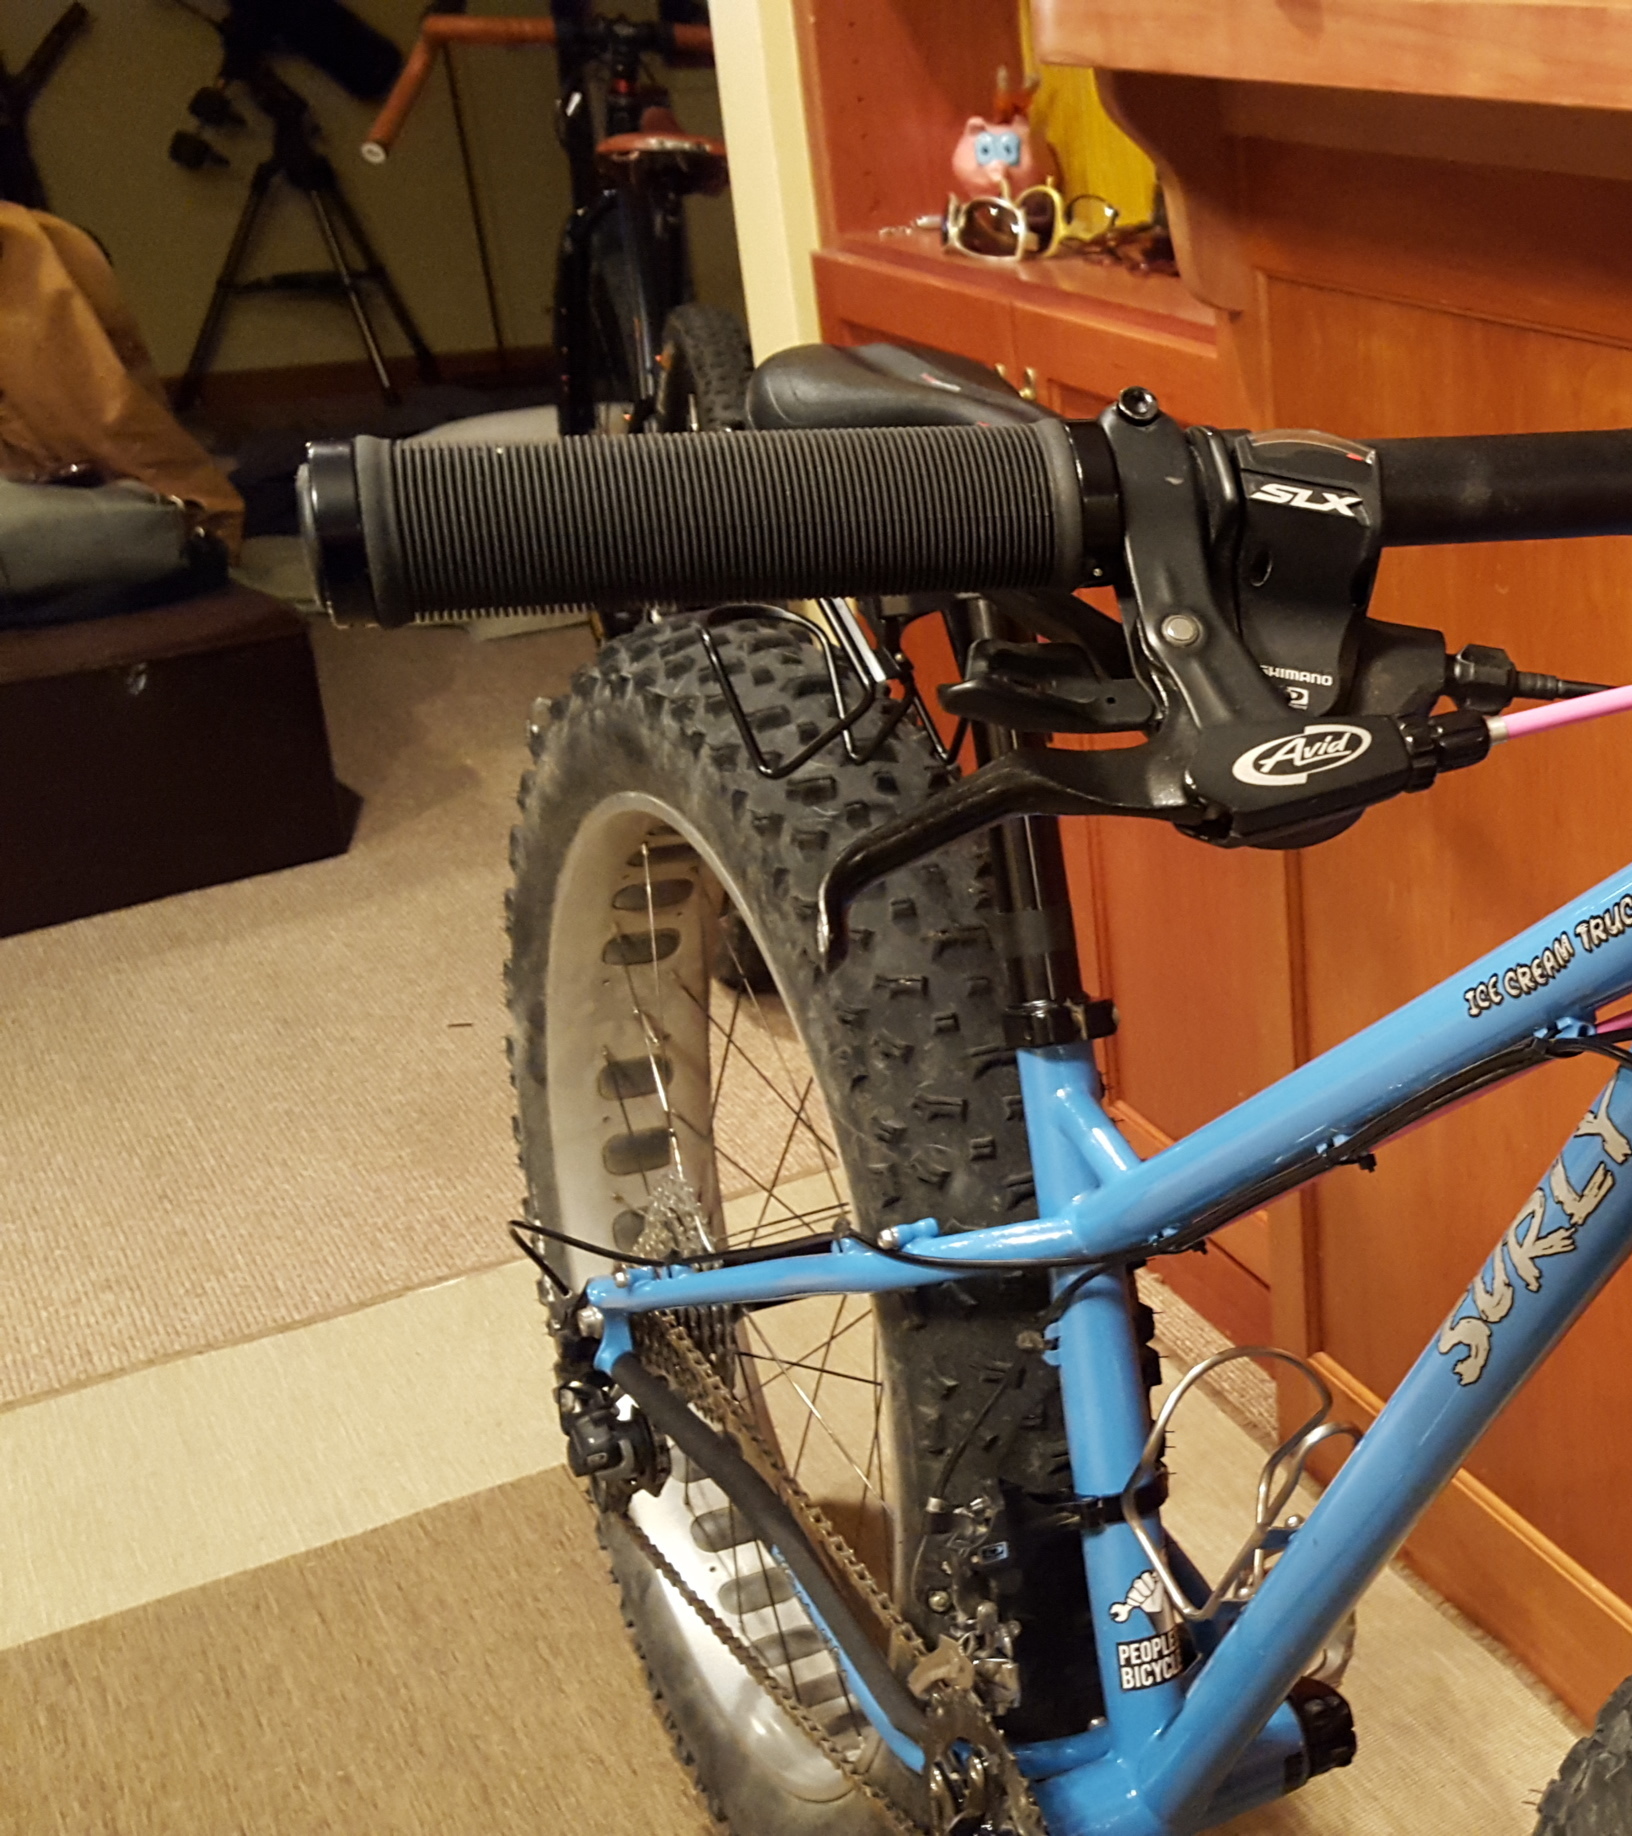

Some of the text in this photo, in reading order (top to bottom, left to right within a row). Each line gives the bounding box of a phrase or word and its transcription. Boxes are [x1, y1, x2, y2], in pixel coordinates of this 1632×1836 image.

[1250, 483, 1363, 517] SLX
[1258, 733, 1352, 774] Avid
[1464, 973, 1503, 1017] ICE
[1503, 931, 1575, 997] CREAM
